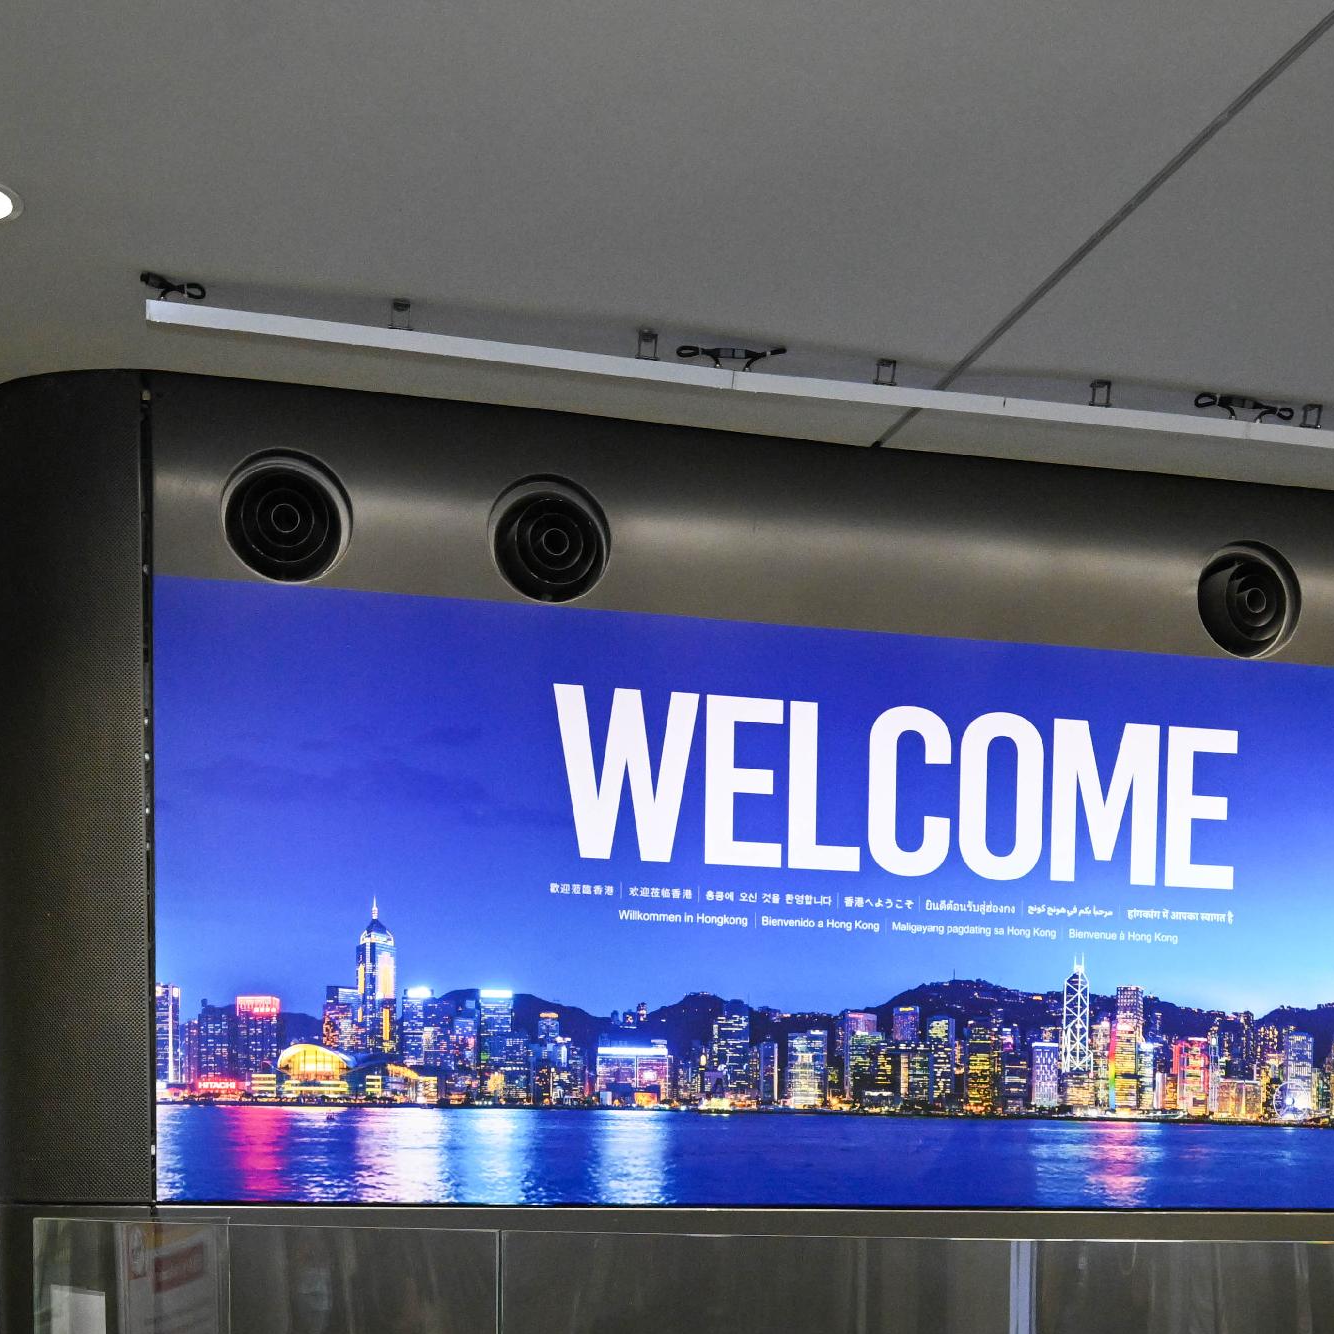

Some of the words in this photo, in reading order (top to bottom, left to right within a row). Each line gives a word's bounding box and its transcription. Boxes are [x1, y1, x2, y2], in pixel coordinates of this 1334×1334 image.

[553, 683, 1238, 890] WELCOME
[739, 892, 757, 902] 오신
[762, 893, 779, 904] 것을
[785, 894, 832, 905] 환영합니다
[844, 897, 914, 909] 香港へようこそ
[619, 909, 682, 923] Willkommen
[684, 911, 693, 923] in
[697, 913, 748, 927] Hongkong
[761, 915, 815, 928] Bienvenido
[818, 919, 824, 928] a
[827, 919, 853, 931] Hong
[855, 920, 880, 932] Kong
[892, 921, 944, 935] Maligayang
[947, 925, 991, 937] pagdating
[994, 927, 1004, 936] sa
[1007, 926, 1031, 939] Hong
[1033, 927, 1056, 940] Kong
[1069, 928, 1117, 940] Bienvenue
[1128, 931, 1152, 943] Hong
[1154, 932, 1178, 944] Kong
[198, 1081, 236, 1089] HITACHI
